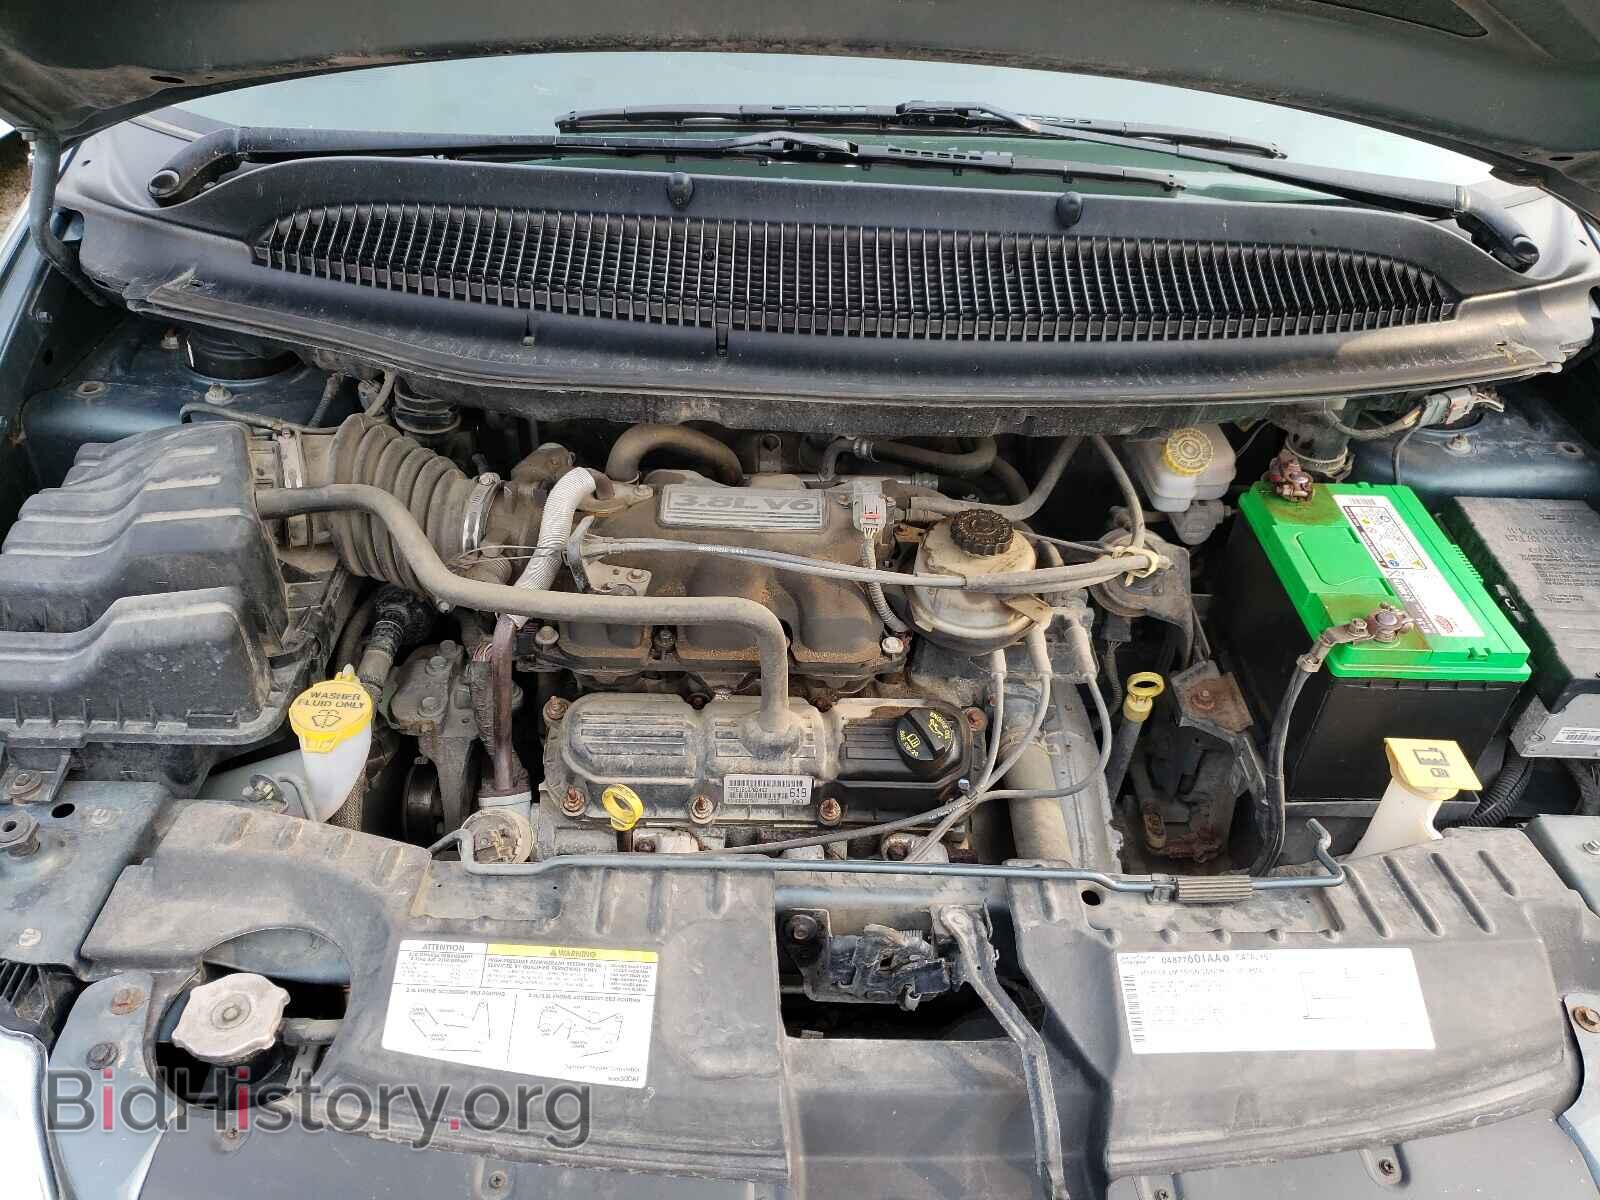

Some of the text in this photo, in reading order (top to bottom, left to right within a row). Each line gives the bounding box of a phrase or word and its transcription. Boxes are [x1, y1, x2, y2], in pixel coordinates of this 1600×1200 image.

[674, 494, 814, 511] 3.8L V6
[310, 691, 361, 701] WASHER
[297, 698, 364, 709] FLUID ONLY
[422, 943, 465, 952] ATTENTION
[558, 949, 597, 959] WARNING
